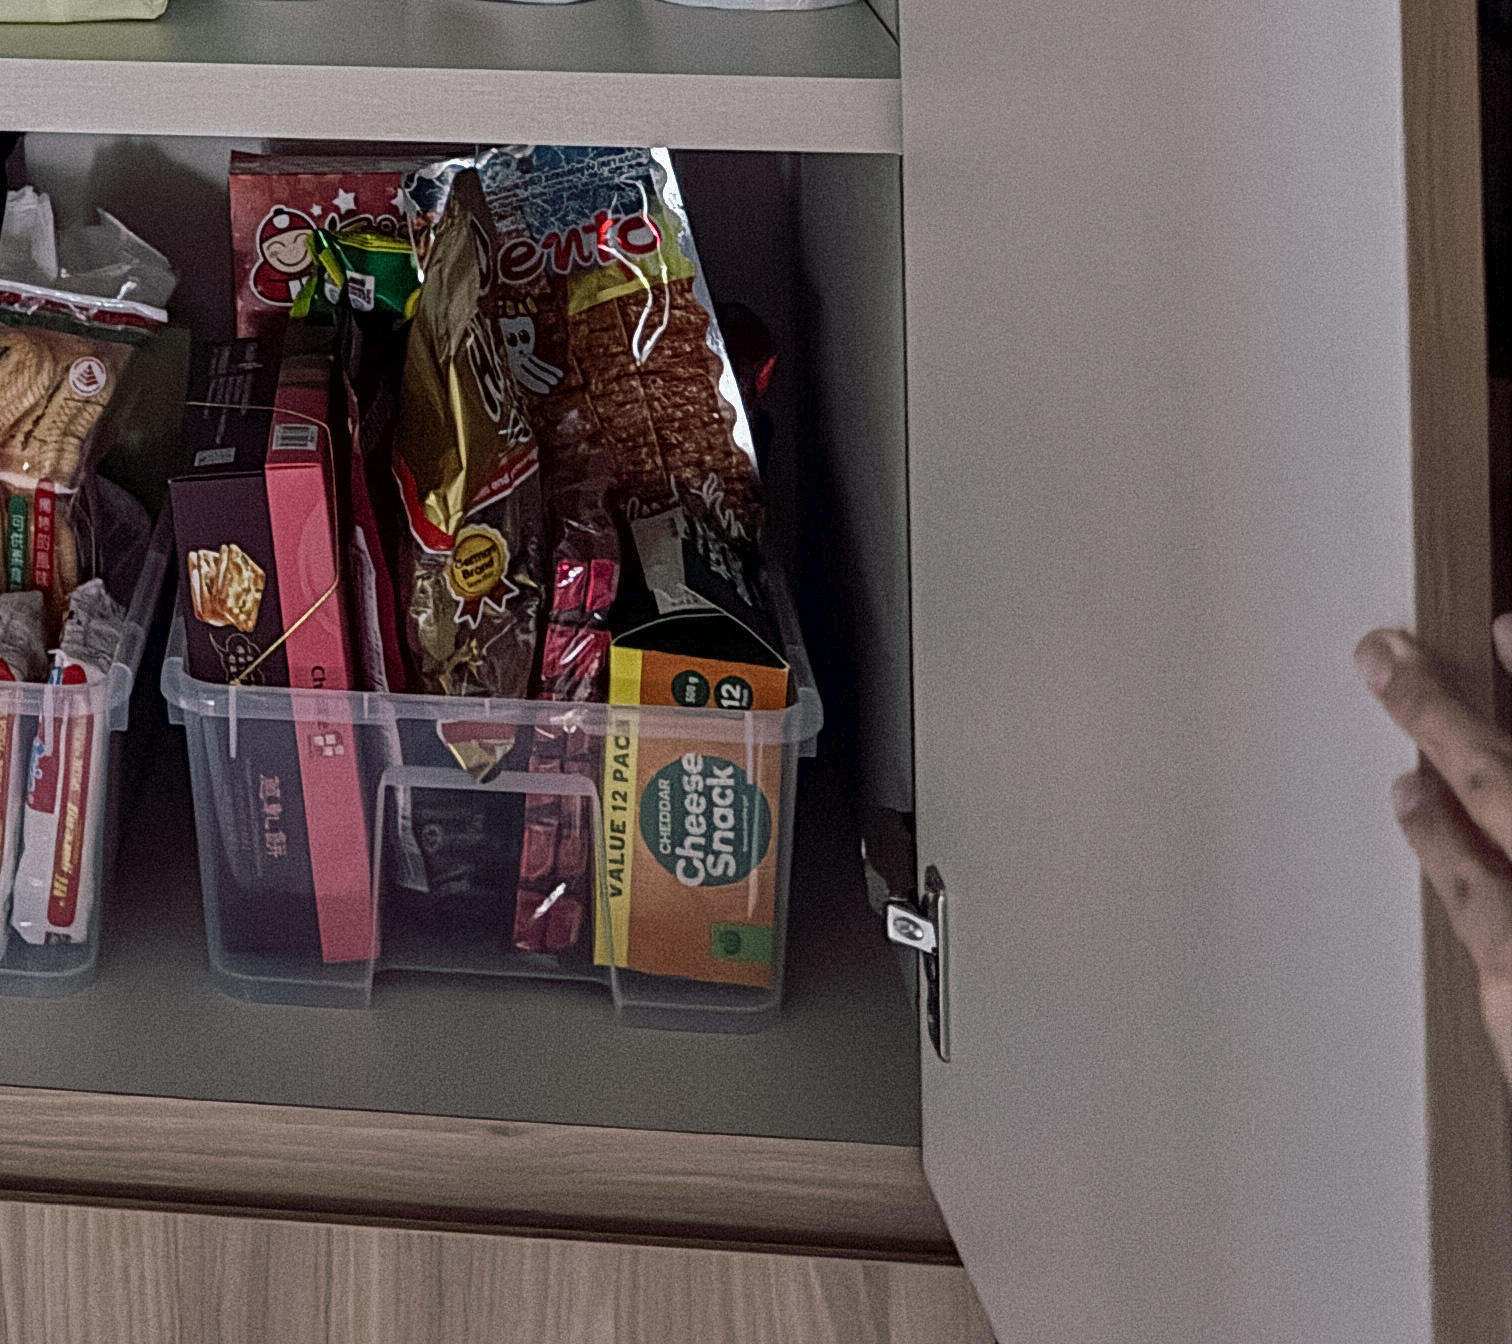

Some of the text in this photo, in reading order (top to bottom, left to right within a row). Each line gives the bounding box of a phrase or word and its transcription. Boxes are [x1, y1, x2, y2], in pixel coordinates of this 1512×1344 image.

[496, 209, 664, 284] ento
[720, 683, 741, 707] 12
[611, 789, 627, 813] 12
[658, 778, 672, 855] CHEDDAR
[674, 751, 708, 887] Cheese
[705, 765, 737, 878] Snack
[607, 819, 626, 899] VALUE
